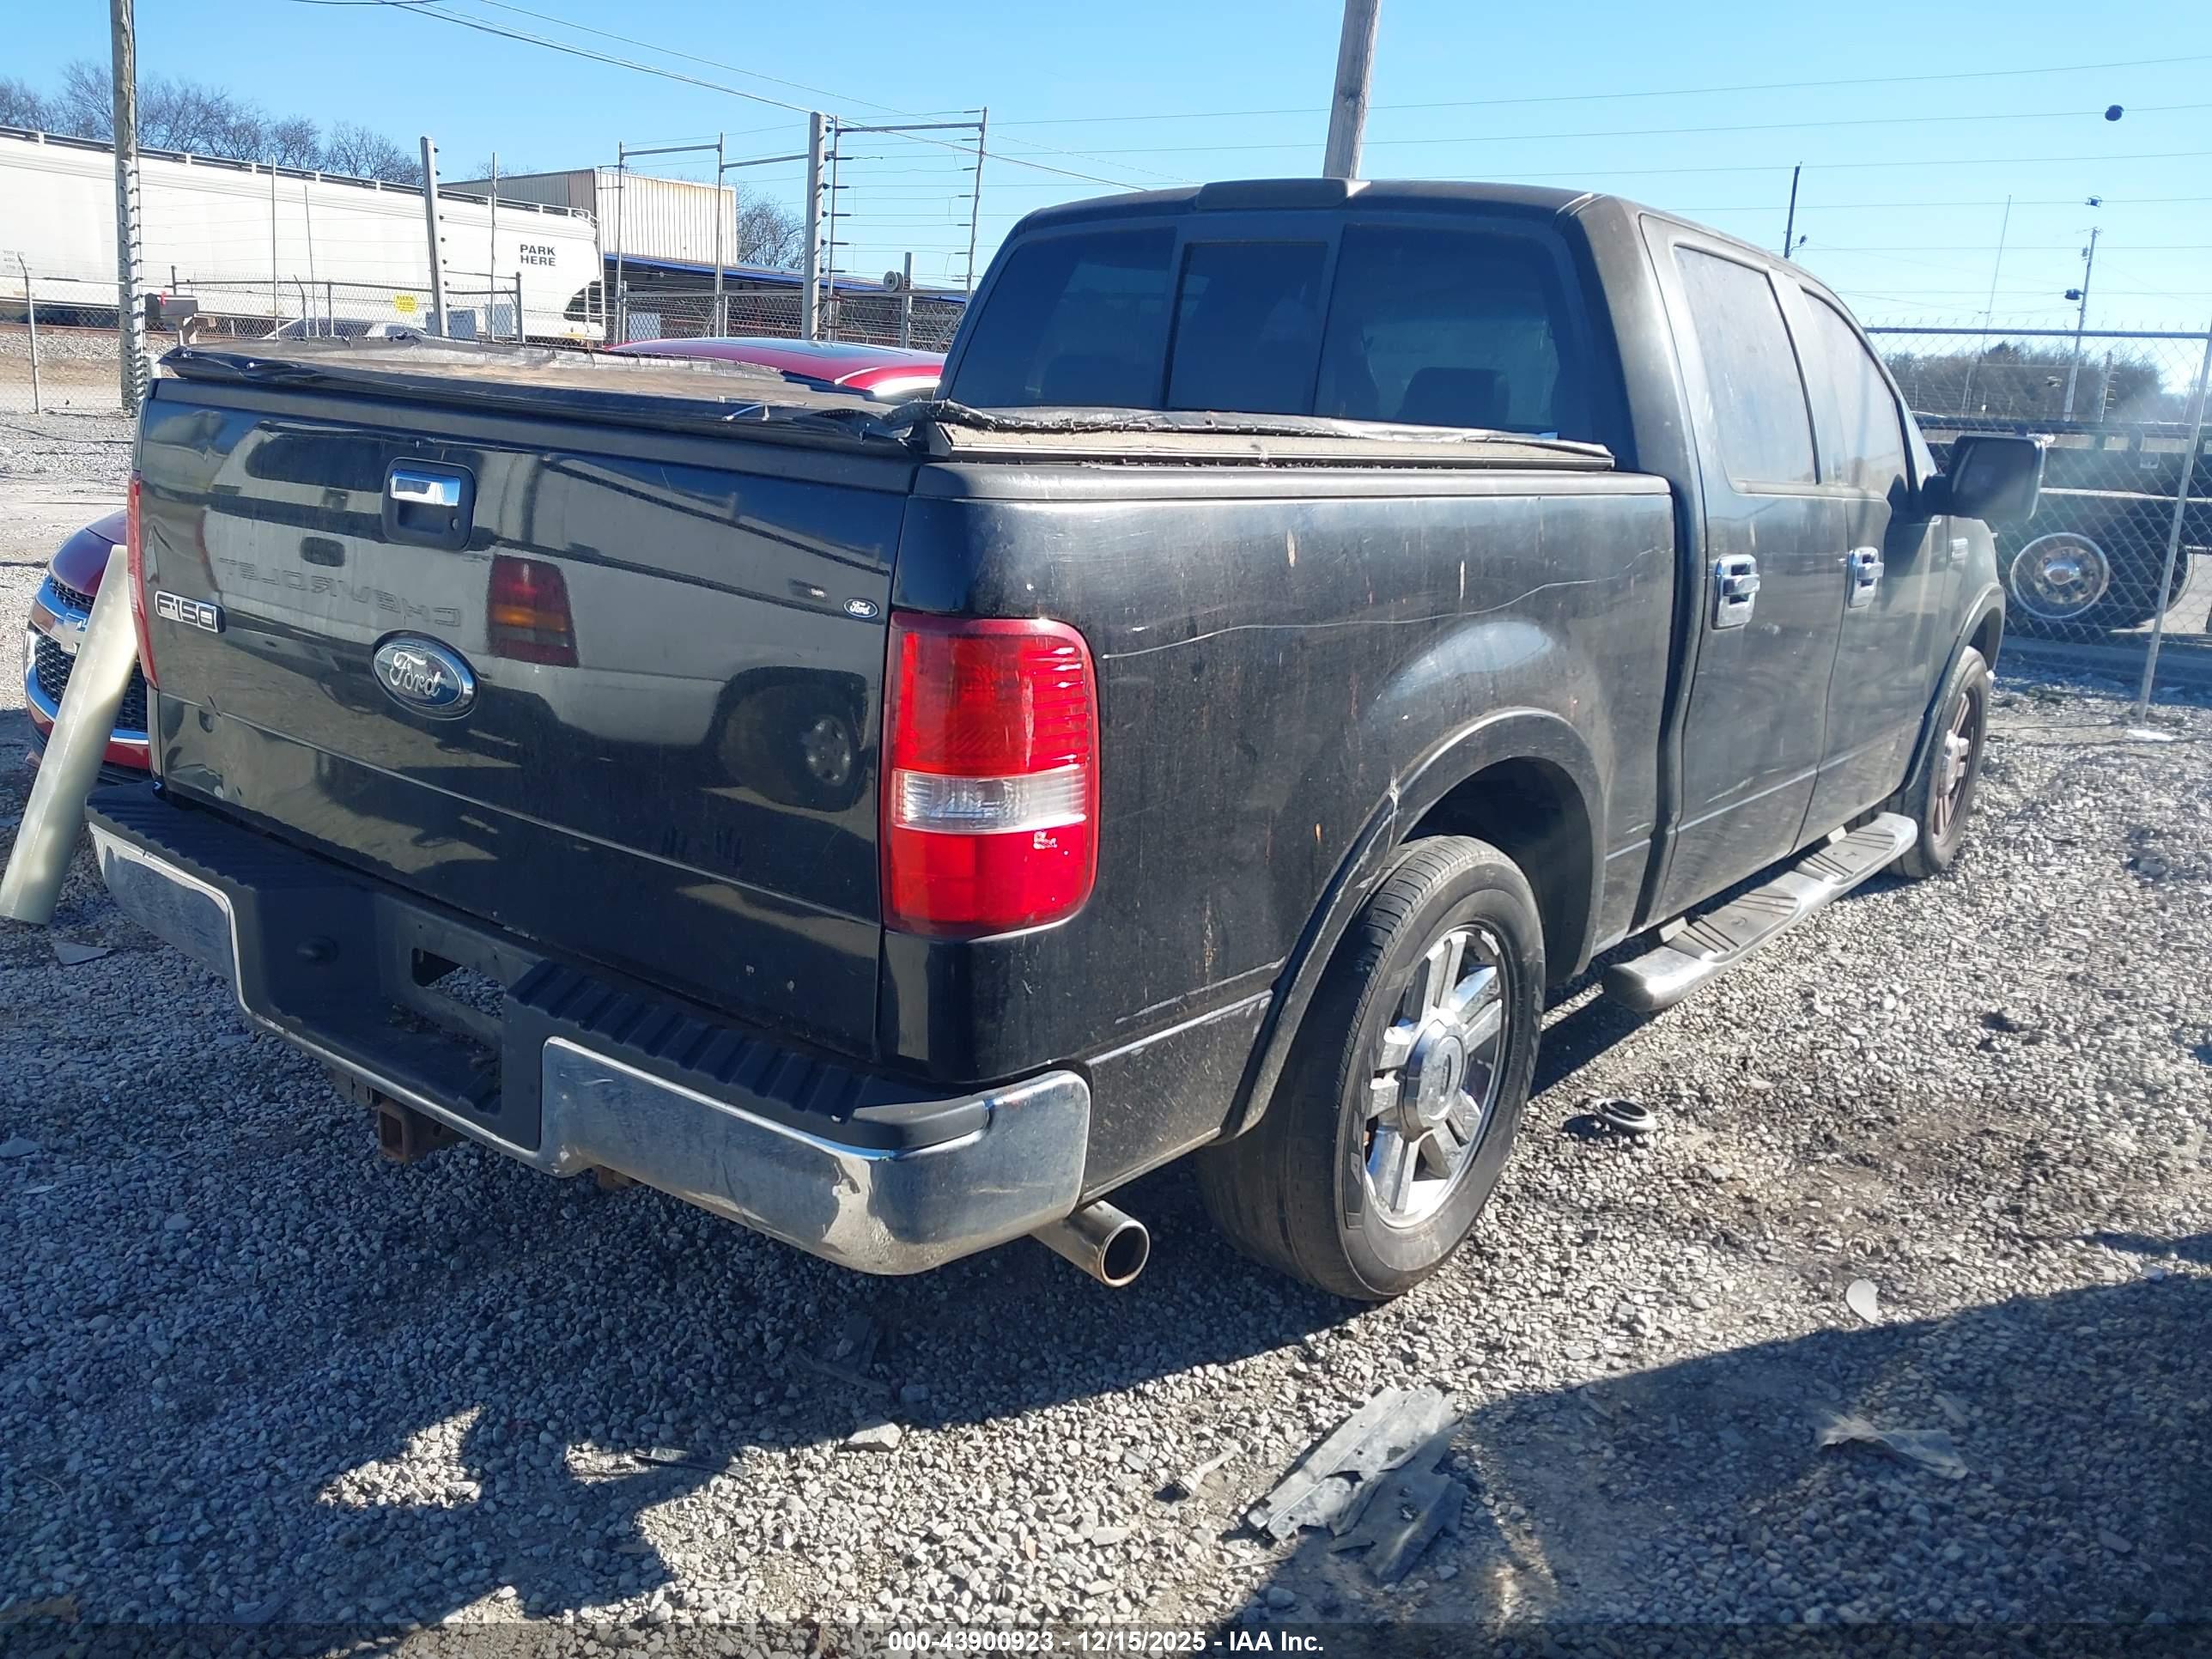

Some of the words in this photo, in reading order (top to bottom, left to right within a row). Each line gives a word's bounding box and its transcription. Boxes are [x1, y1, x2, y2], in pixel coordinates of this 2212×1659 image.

[520, 244, 556, 257] PARK
[520, 254, 556, 267] HERE
[849, 600, 871, 615] Ford
[389, 651, 441, 697] Ford
